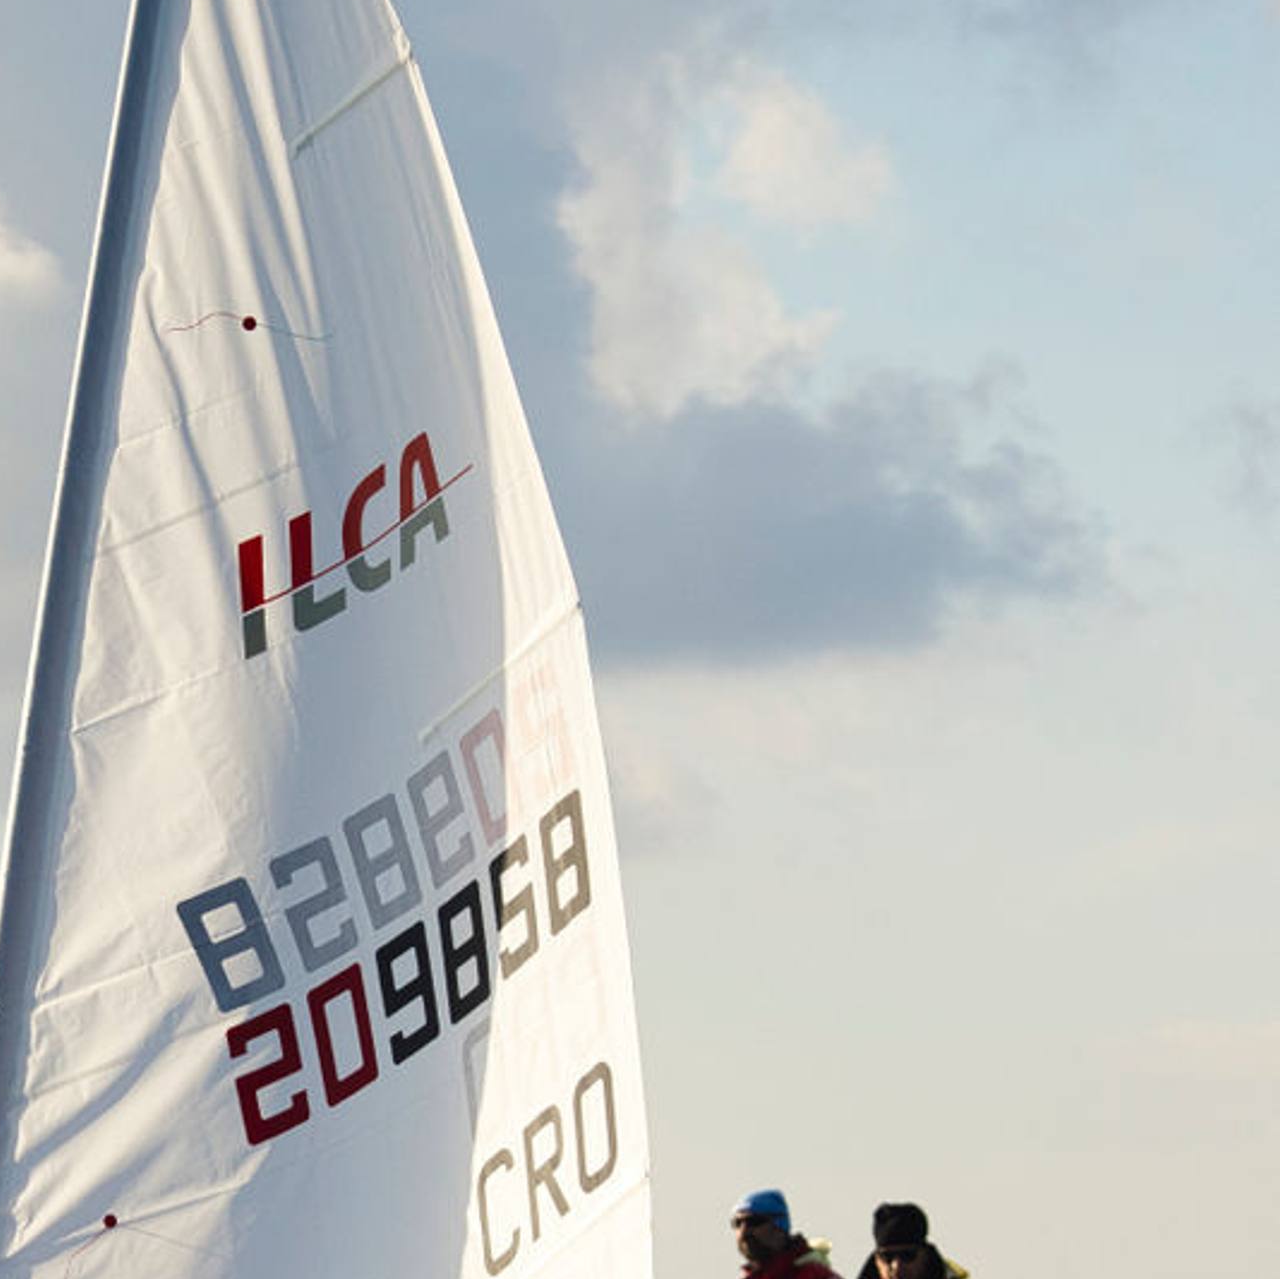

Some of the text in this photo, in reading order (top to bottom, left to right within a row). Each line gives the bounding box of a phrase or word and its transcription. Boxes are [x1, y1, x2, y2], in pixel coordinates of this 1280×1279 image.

[237, 431, 451, 660] ILCA
[225, 788, 592, 1148] 209858
[476, 1060, 619, 1277] CRO
